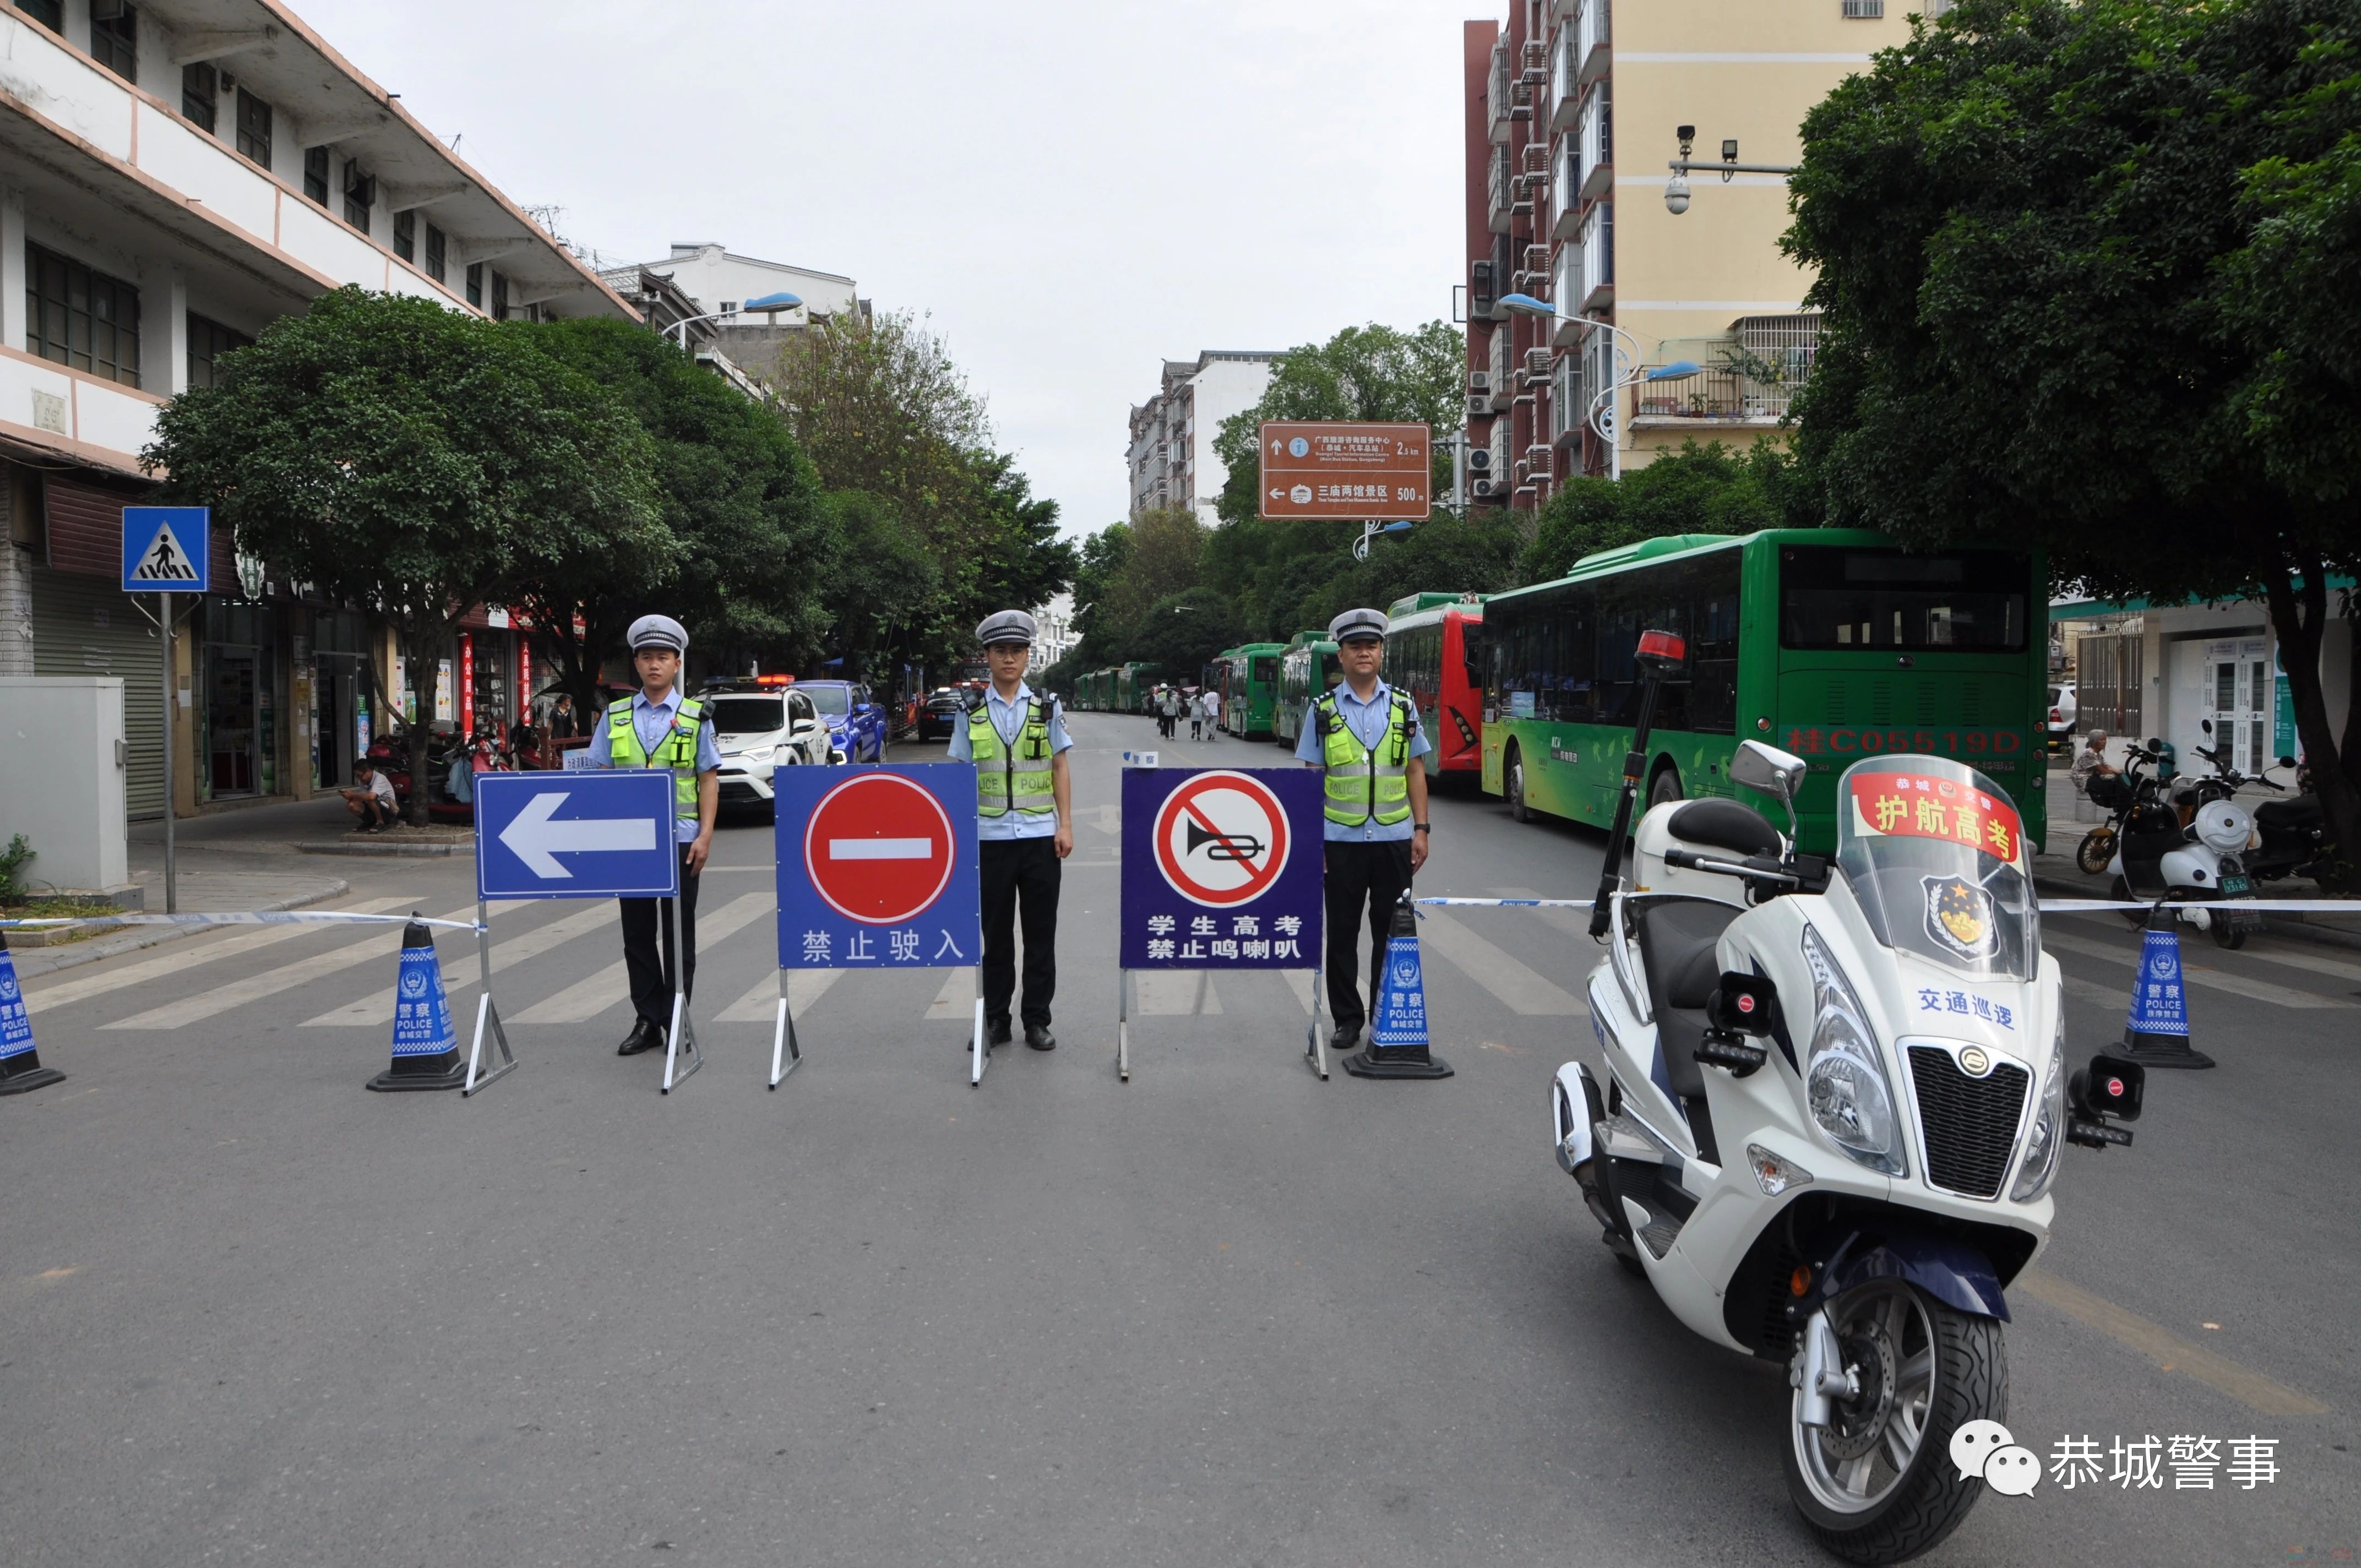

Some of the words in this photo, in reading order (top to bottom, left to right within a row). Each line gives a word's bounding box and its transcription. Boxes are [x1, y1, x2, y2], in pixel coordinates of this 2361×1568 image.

[1397, 442, 1408, 455] 2.5
[1318, 485, 1388, 497] 三庙两馆景区
[1397, 488, 1416, 501] 500
[1786, 727, 2020, 754] 桂C05519D
[978, 778, 998, 790] LICE
[1021, 777, 1051, 790] POLIC
[1330, 783, 1360, 795] POLICE
[1896, 777, 1929, 792] 恭城
[1874, 794, 2010, 859] 护航高考
[1147, 915, 1302, 936] 学生高考
[802, 929, 964, 962] 禁止驶入
[1147, 939, 1302, 960] 禁止鸣喇叭
[2148, 984, 2179, 998] 警察
[1391, 993, 1422, 1008] 警察
[2146, 1000, 2181, 1009] POLICE
[1, 1002, 24, 1020] 警察
[399, 1003, 429, 1019] 警察
[1389, 1009, 1424, 1019] POLICE
[1918, 989, 2015, 1030] 交通巡逻
[2, 1017, 29, 1031] POLICE
[397, 1019, 432, 1030] POLICE
[399, 1030, 431, 1039] 恭城交警
